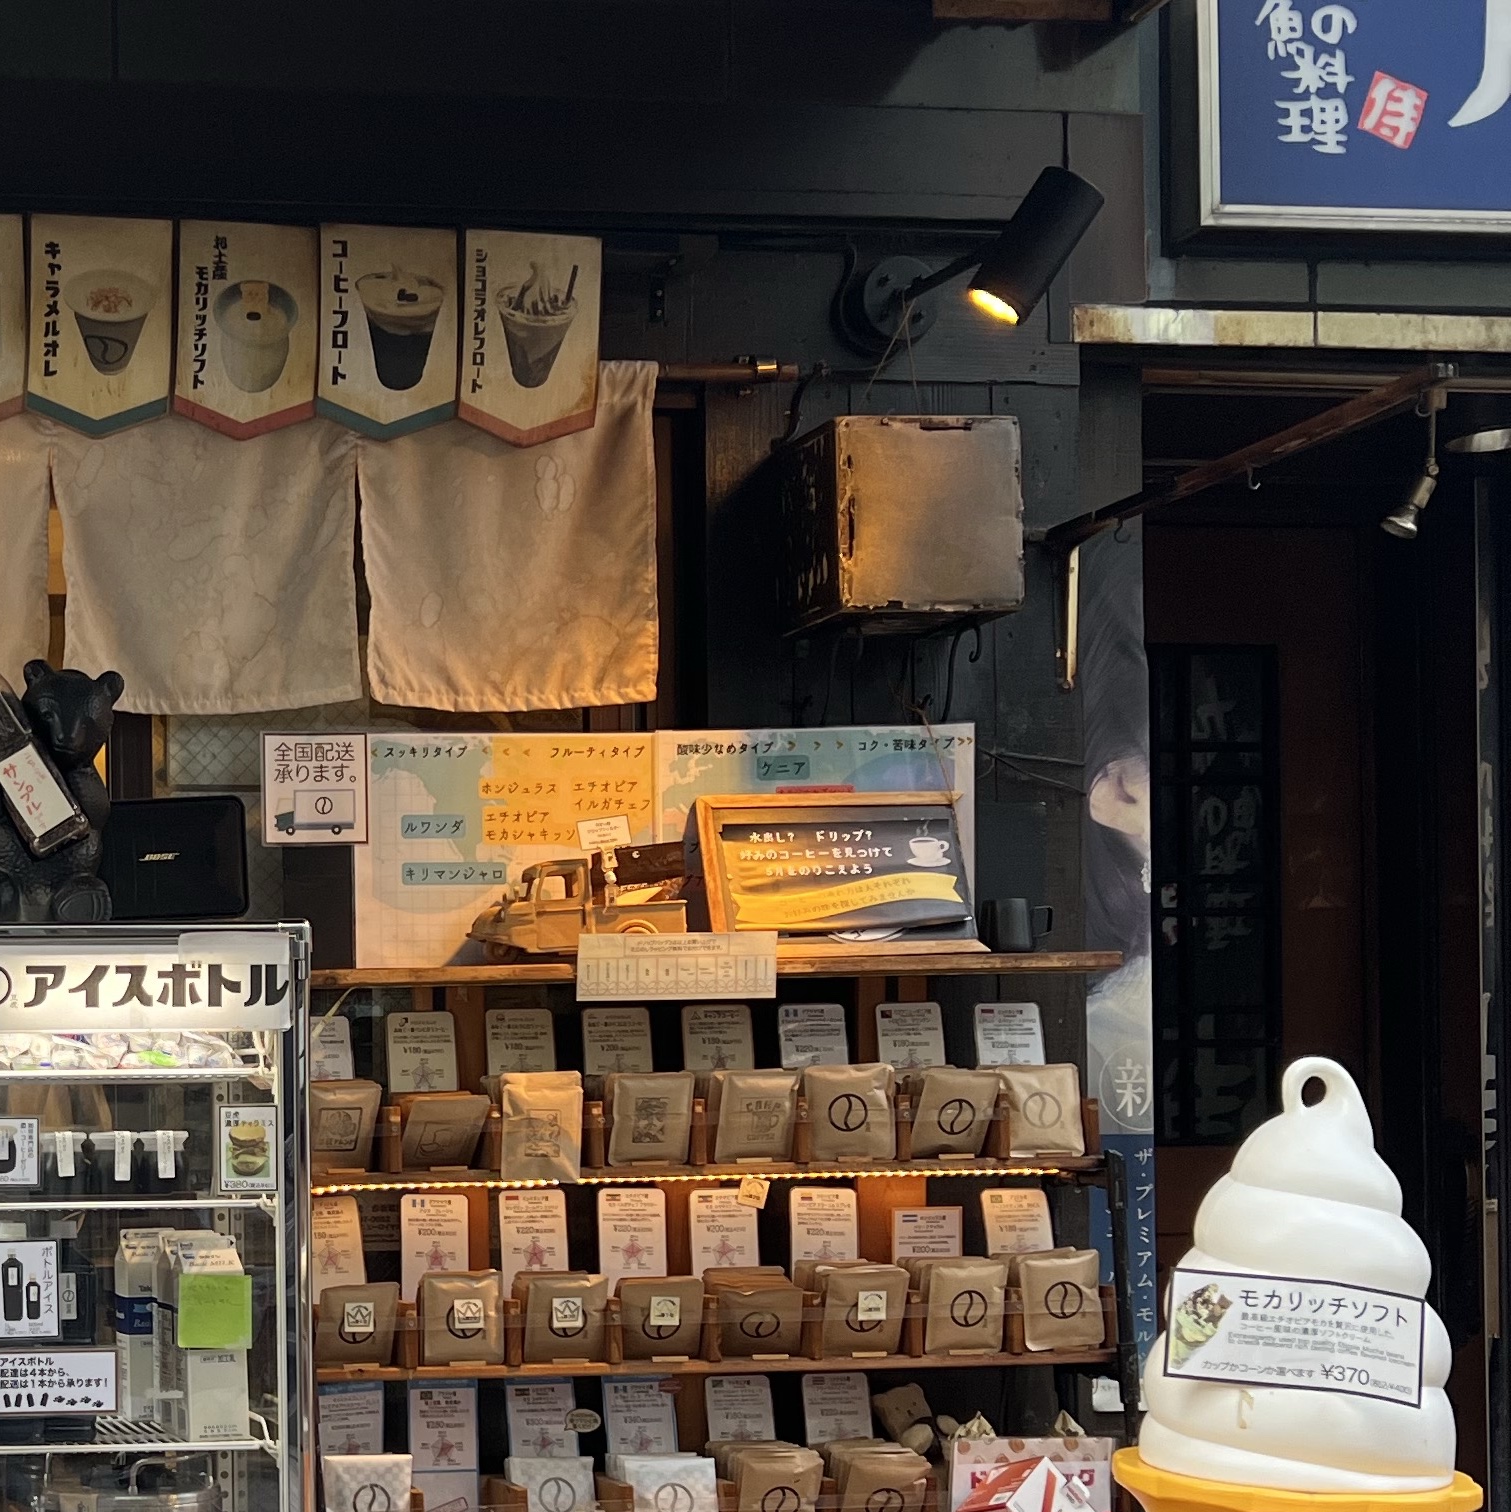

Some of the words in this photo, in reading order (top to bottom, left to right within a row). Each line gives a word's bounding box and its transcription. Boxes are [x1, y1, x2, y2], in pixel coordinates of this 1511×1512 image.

[44, 241, 62, 378] キャラメルオレ
[331, 239, 349, 386] コーヒーフロート
[192, 265, 209, 390] モカリッチソフト
[471, 248, 488, 394] ショコラオレフロート
[273, 742, 356, 762] 全国配送
[383, 745, 468, 758] スッキリタイプ
[550, 744, 645, 760] フルーティタイプ
[676, 741, 774, 755] 酸味少なめタイプ
[273, 763, 358, 784] 承ります。
[760, 760, 807, 776] ケニア
[3, 763, 42, 816] サンプル
[480, 781, 558, 795] ホンジュラス
[573, 779, 639, 794] エチオピア
[573, 798, 652, 811] イルガチェフ
[486, 811, 551, 824] エチオピア
[404, 819, 465, 835] ルワンダ
[739, 846, 894, 861] 好みのコーヒーを見つけて
[404, 868, 504, 882] キリマンジャロ
[23, 961, 290, 1009] アイスボトル
[42, 1246, 54, 1314] ボトルアイス
[1238, 1288, 1409, 1328] モカリッチソフト
[0, 1357, 55, 1367] アイスボトル
[1320, 1363, 1371, 1386] ¥370
